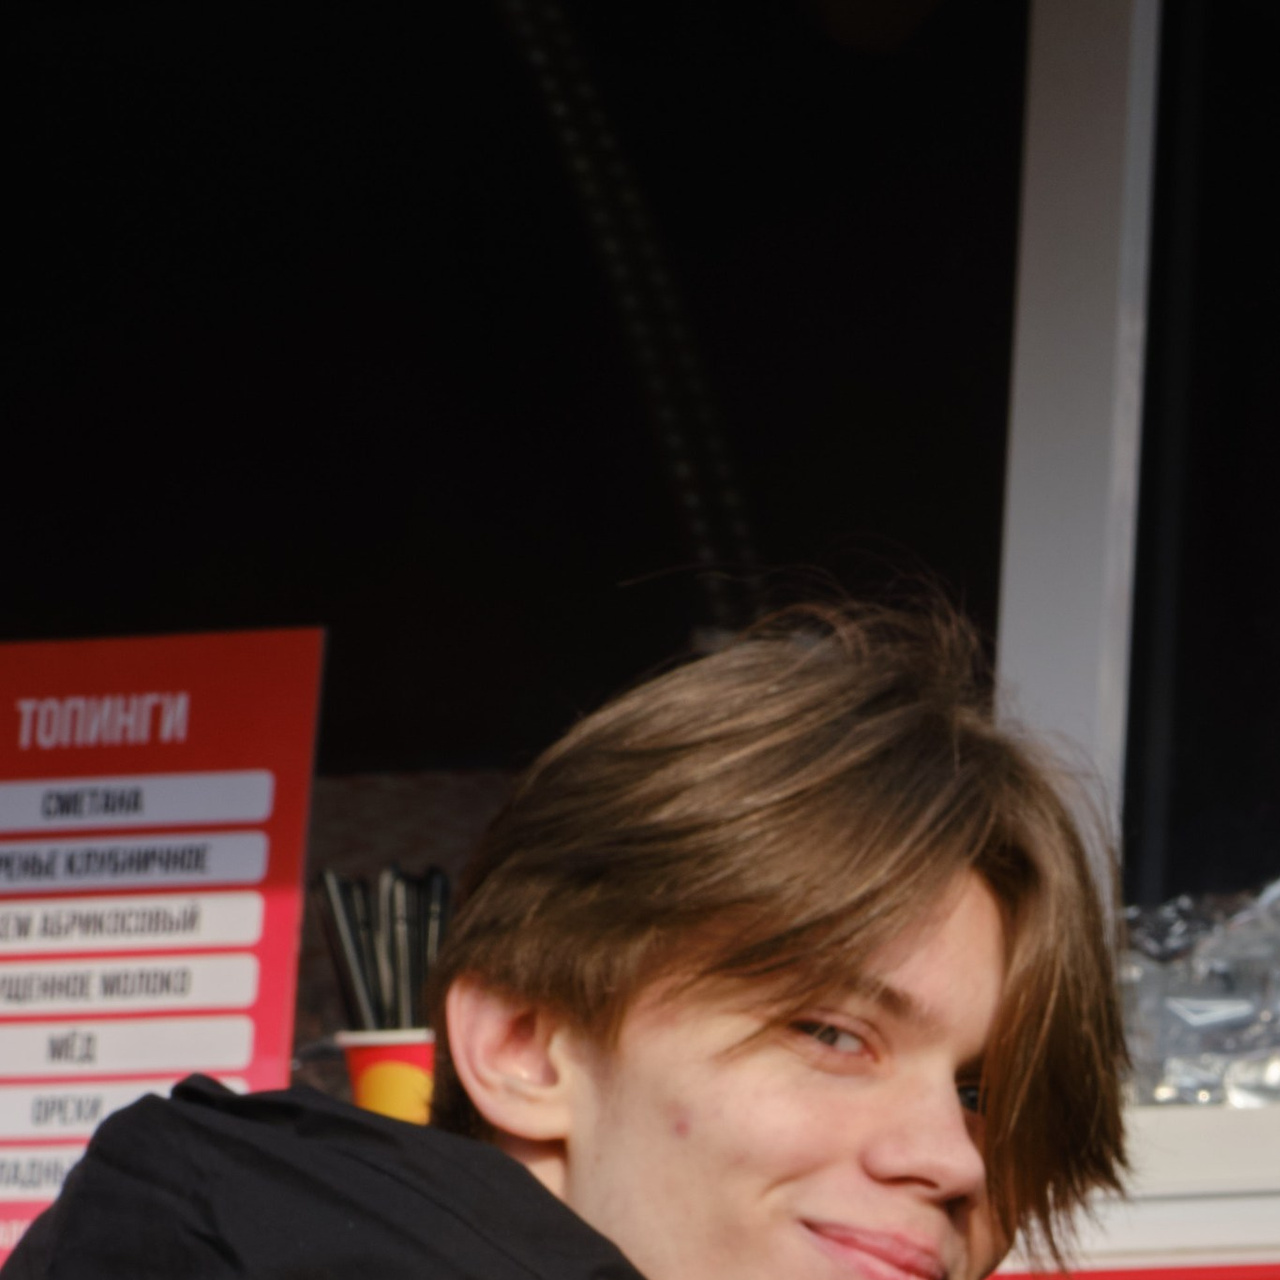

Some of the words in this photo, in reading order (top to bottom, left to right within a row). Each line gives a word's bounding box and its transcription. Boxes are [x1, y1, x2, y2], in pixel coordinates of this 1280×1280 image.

[17, 692, 189, 749] ТОПИНГИ
[41, 786, 144, 819] СМЕТАНА
[64, 844, 210, 877] КЛУБНИЧНОЕ
[0, 912, 33, 940] ЕМ
[40, 902, 201, 938] АБРИКОСОВЫЙ
[100, 966, 192, 997] МОЛОКО
[48, 1030, 96, 1064] МЁД
[32, 1096, 103, 1126] ОРЕХИ
